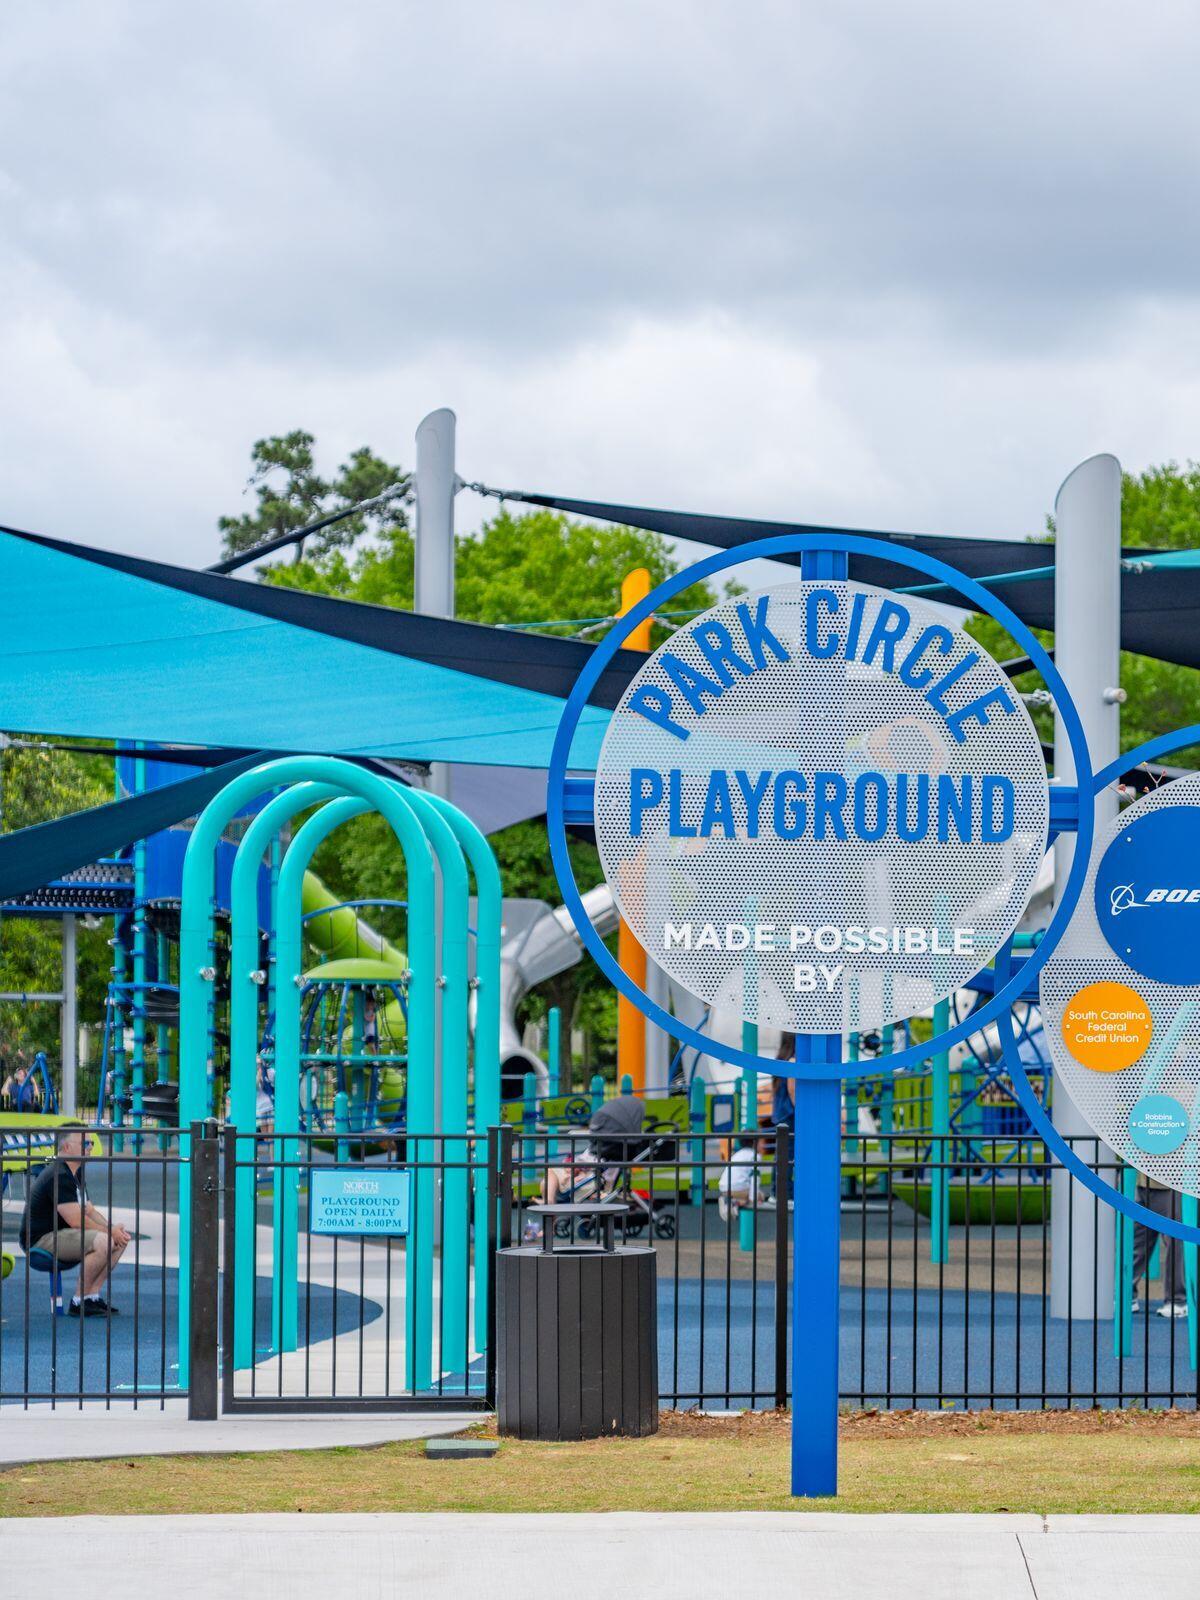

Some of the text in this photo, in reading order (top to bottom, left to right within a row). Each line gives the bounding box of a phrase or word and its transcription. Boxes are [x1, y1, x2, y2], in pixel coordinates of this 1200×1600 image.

[627, 589, 1017, 744] PARK CIRCLE
[629, 767, 1015, 845] PLAYGROUND
[663, 922, 976, 956] MADE POSSIBLE
[793, 964, 844, 993] BY
[1068, 1010, 1146, 1020] South Carolina
[1087, 1022, 1127, 1031] Federal
[1075, 1033, 1139, 1043] Credit Union
[1144, 1113, 1173, 1121] Robbins
[1137, 1120, 1180, 1128] Construction
[1147, 1128, 1170, 1136] Group
[343, 1181, 379, 1190] NORTH
[321, 1197, 400, 1206] PLAYGROUND
[324, 1207, 396, 1217] OPEN DAILY
[318, 1218, 355, 1227] 7:00AM
[365, 1218, 402, 1228] 8:00PM
